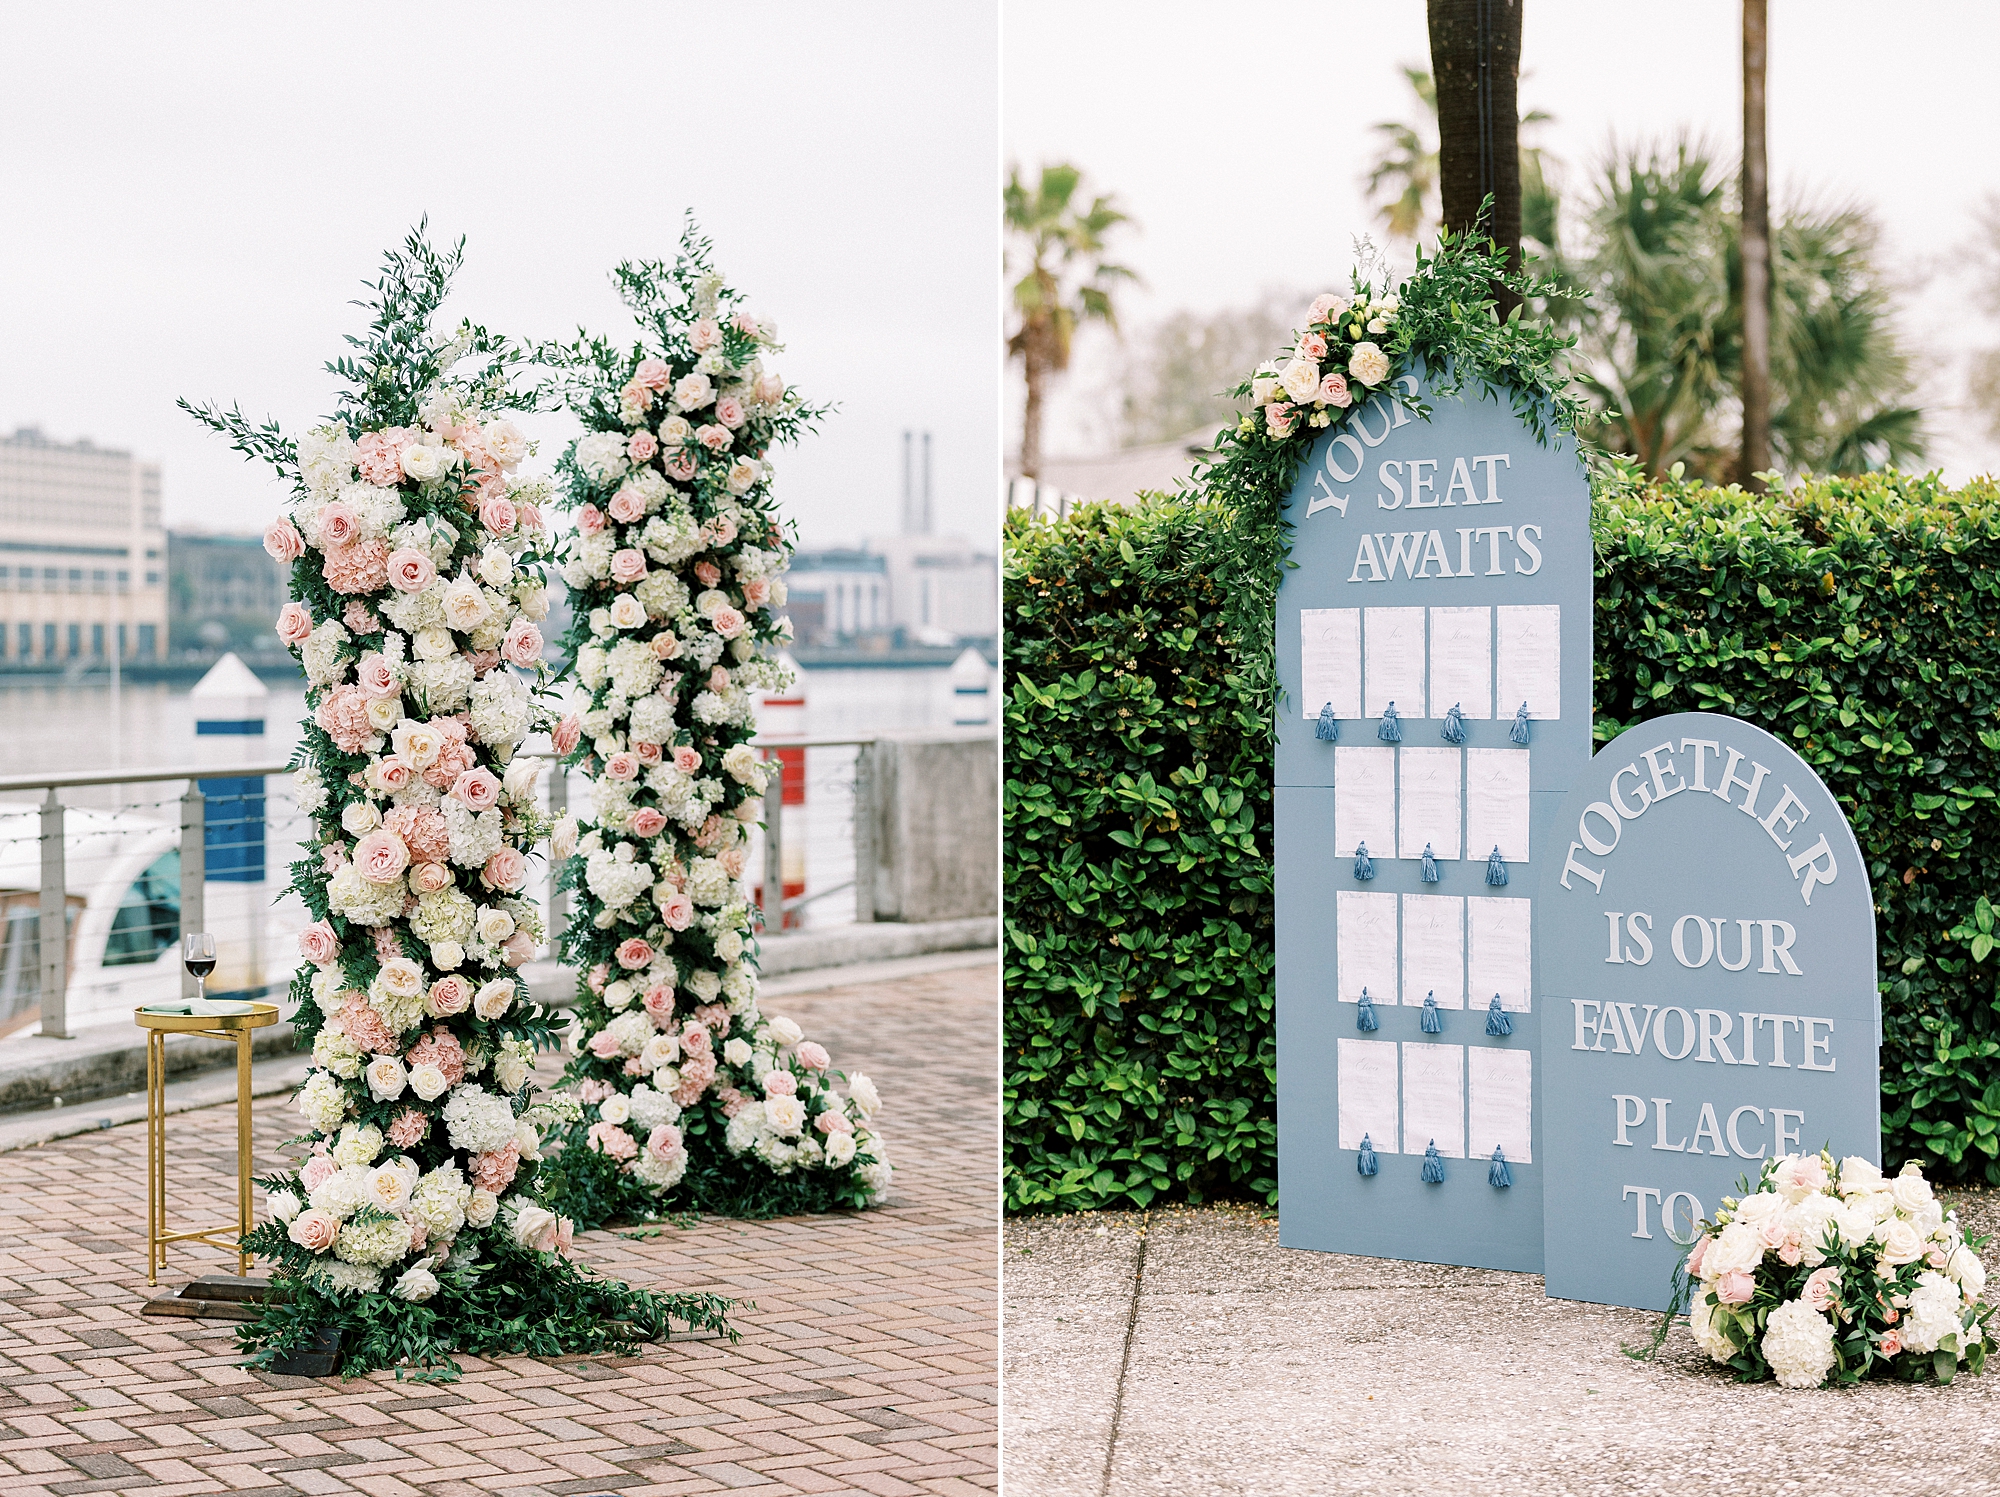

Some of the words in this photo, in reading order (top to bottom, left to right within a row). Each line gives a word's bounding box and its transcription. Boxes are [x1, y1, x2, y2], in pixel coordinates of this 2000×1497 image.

[1306, 374, 1432, 519] YOUR
[1377, 453, 1511, 511] SEAT
[1347, 524, 1542, 583] AWAITS
[1559, 737, 1838, 907] TOGETHER
[1604, 911, 1654, 966] IS
[1671, 914, 1804, 976] OUR
[1570, 998, 1837, 1072] FAVORITE
[1611, 1094, 1807, 1160] PLACE
[1622, 1185, 1705, 1246] TO
